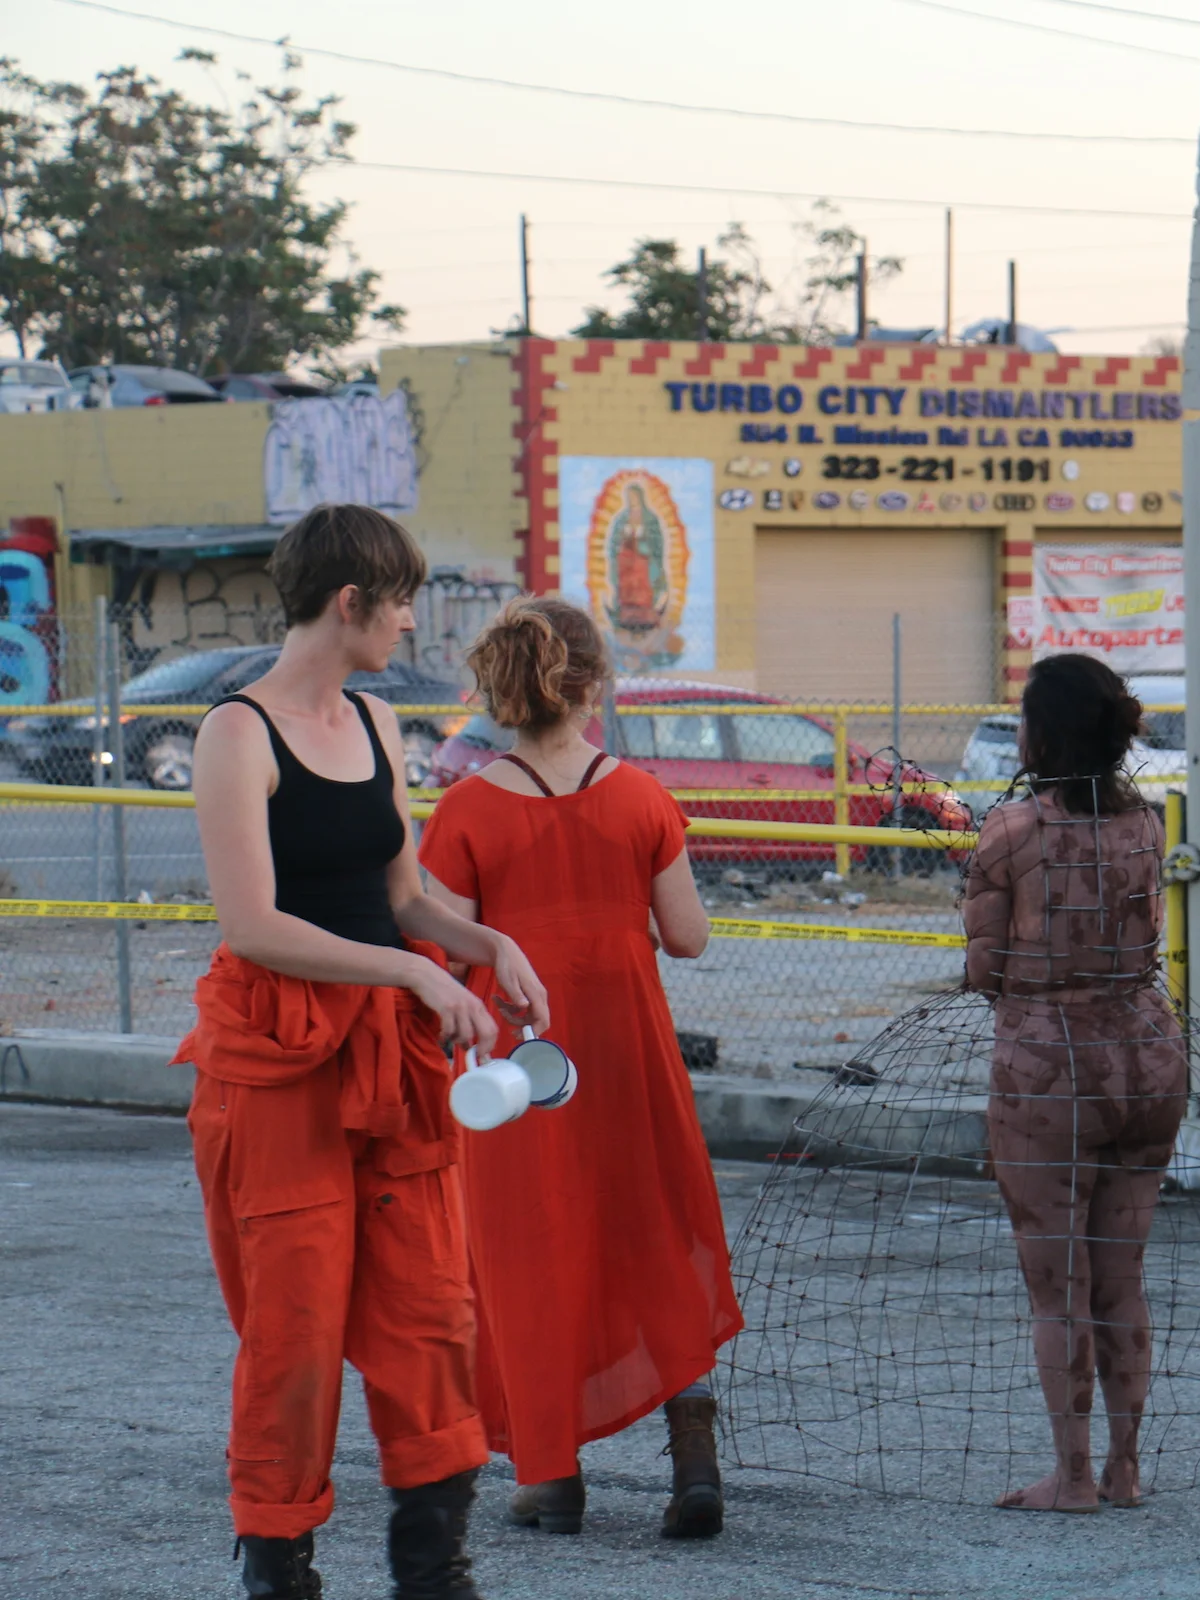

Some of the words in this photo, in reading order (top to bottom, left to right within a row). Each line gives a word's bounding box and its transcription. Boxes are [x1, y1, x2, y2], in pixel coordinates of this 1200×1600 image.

[665, 382, 802, 414] TURBO
[818, 385, 906, 415] CITY
[919, 388, 1182, 421] DISMANTLERS
[977, 427, 1008, 446] LA
[1018, 428, 1049, 447] CA
[822, 455, 1051, 481] 323-221-1191
